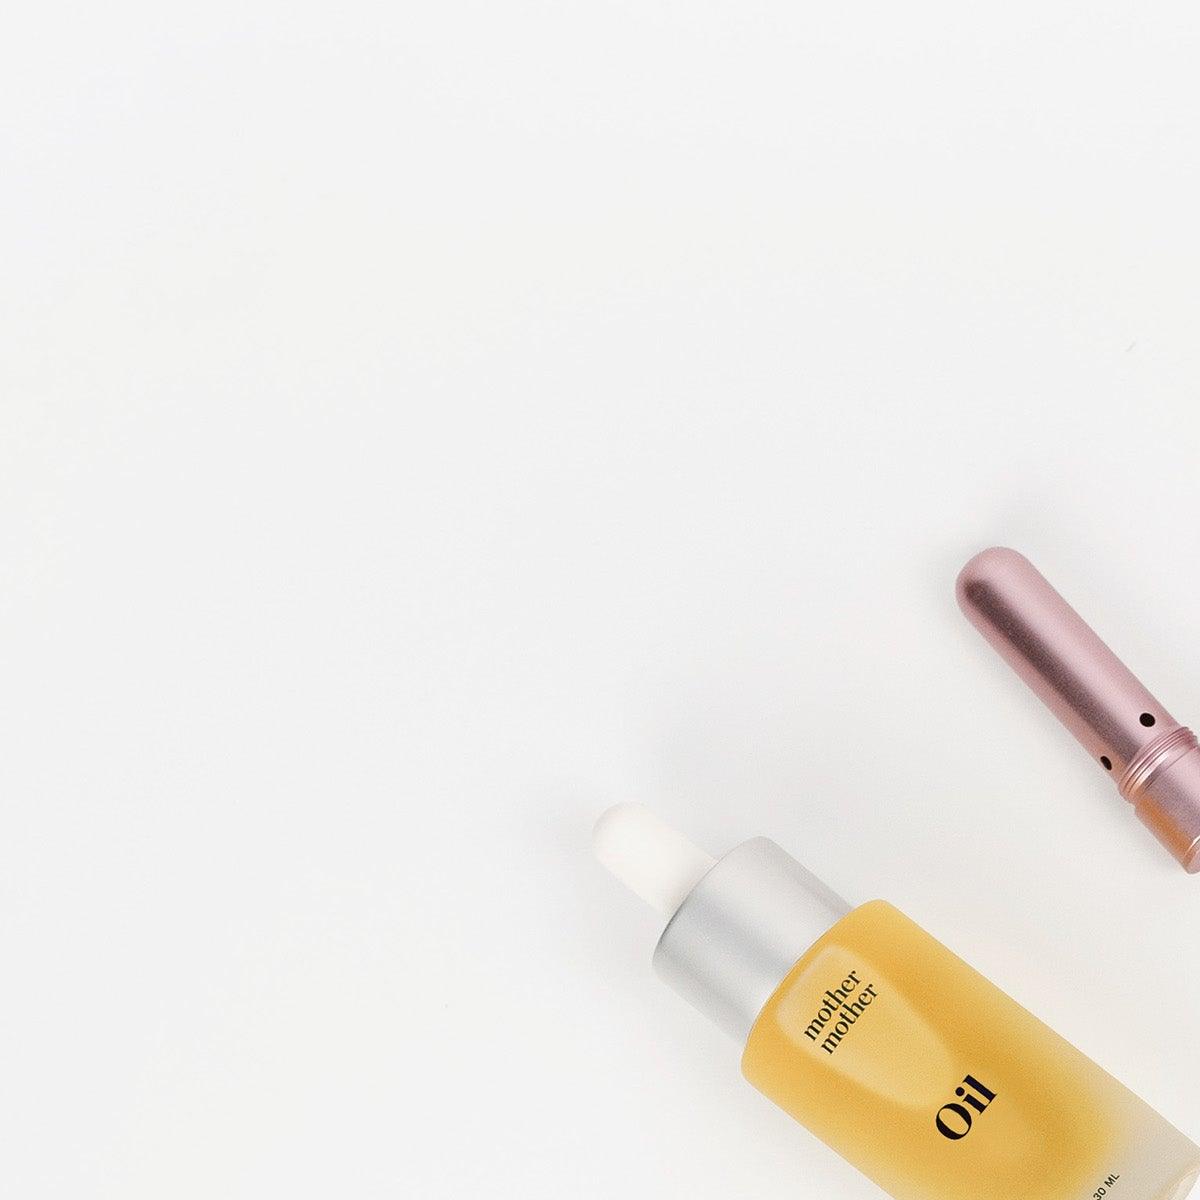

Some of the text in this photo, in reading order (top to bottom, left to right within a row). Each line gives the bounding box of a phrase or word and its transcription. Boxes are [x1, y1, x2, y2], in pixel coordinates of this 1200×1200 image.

[803, 970, 862, 1041] mother
[820, 983, 878, 1055] mother
[935, 1074, 998, 1140] Oil
[1092, 1187, 1107, 1200] 30
[1103, 1173, 1120, 1188] ML
